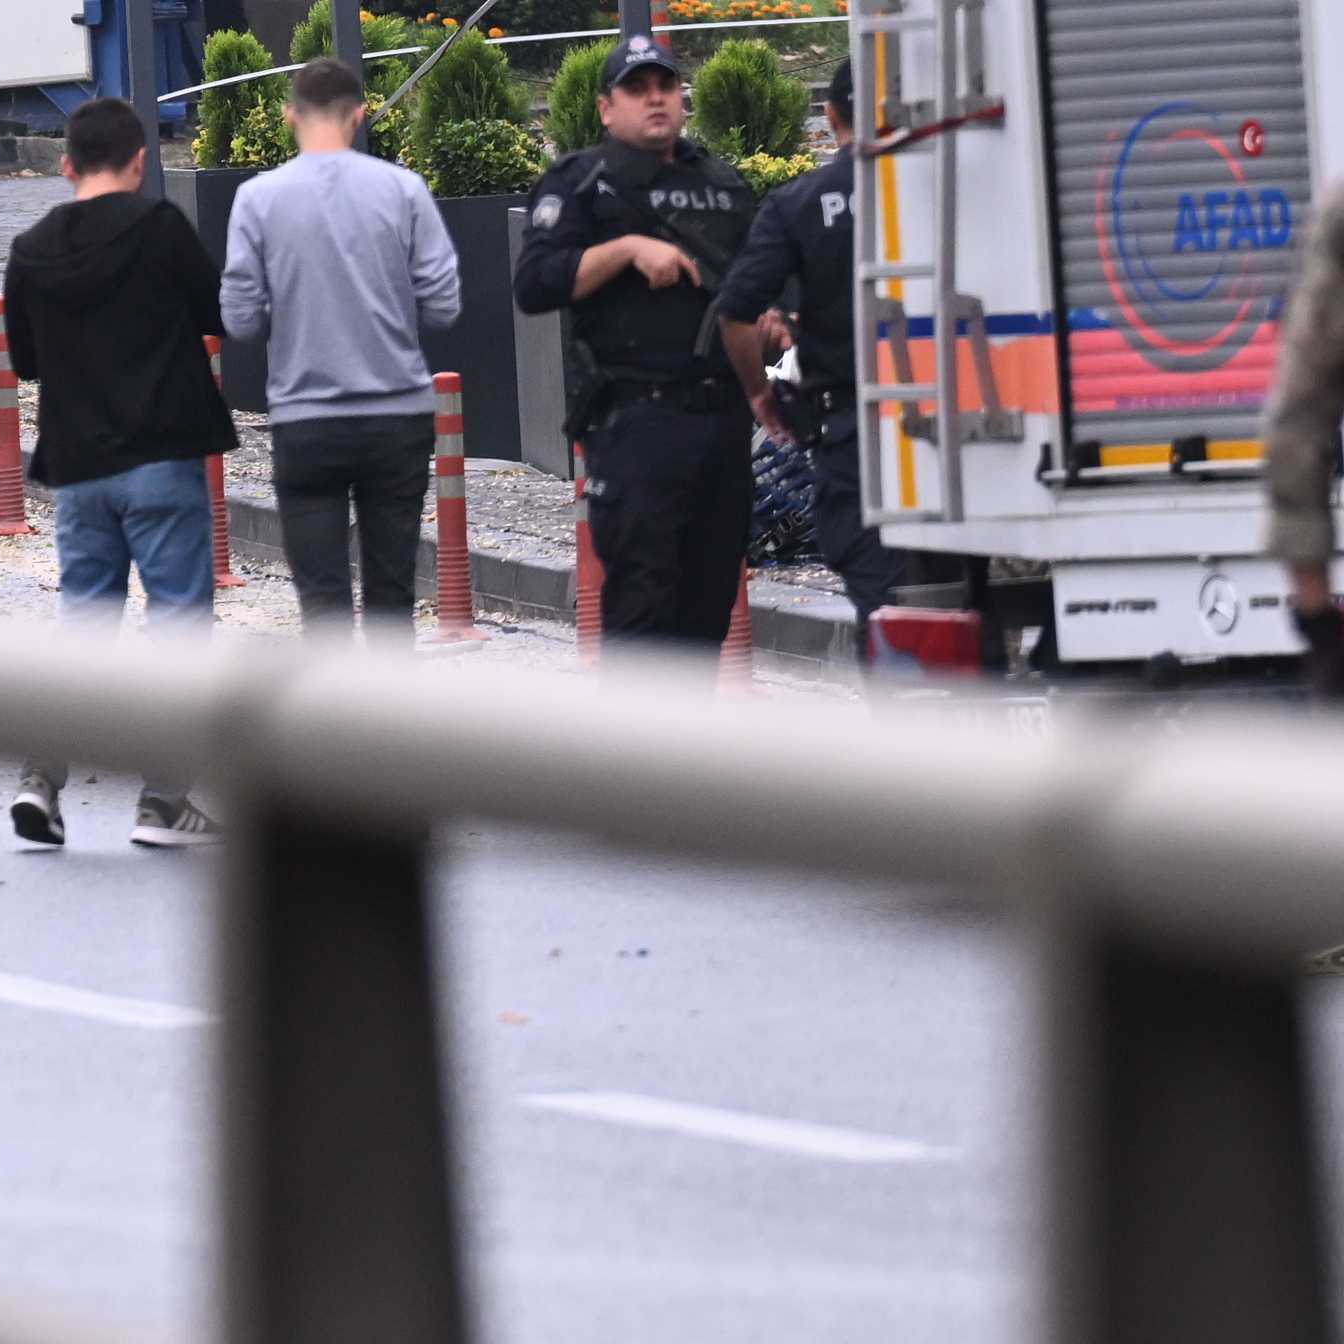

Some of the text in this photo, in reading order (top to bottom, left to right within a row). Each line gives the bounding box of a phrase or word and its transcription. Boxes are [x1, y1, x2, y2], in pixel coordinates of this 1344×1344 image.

[649, 186, 732, 210] POLİS
[820, 191, 854, 227] P
[1173, 187, 1291, 252] AFAD
